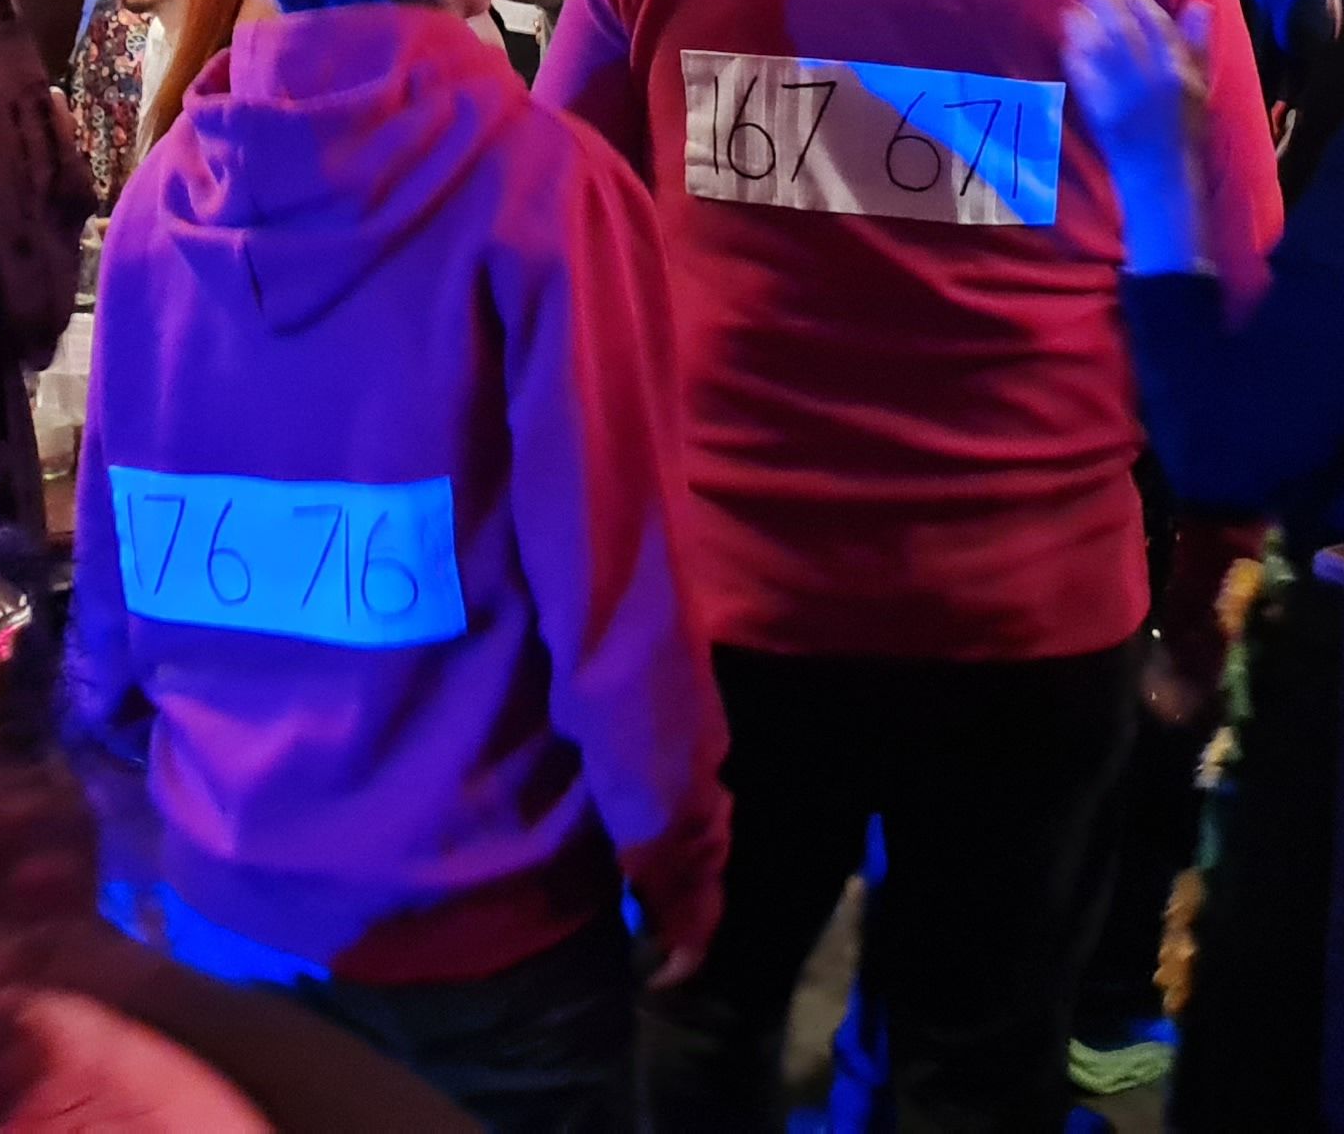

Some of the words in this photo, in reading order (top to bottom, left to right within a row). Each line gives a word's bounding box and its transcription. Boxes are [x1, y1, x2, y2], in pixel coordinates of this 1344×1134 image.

[712, 74, 838, 183] 167
[885, 89, 1024, 200] 671
[126, 491, 252, 607] 176
[291, 501, 420, 628] 716
